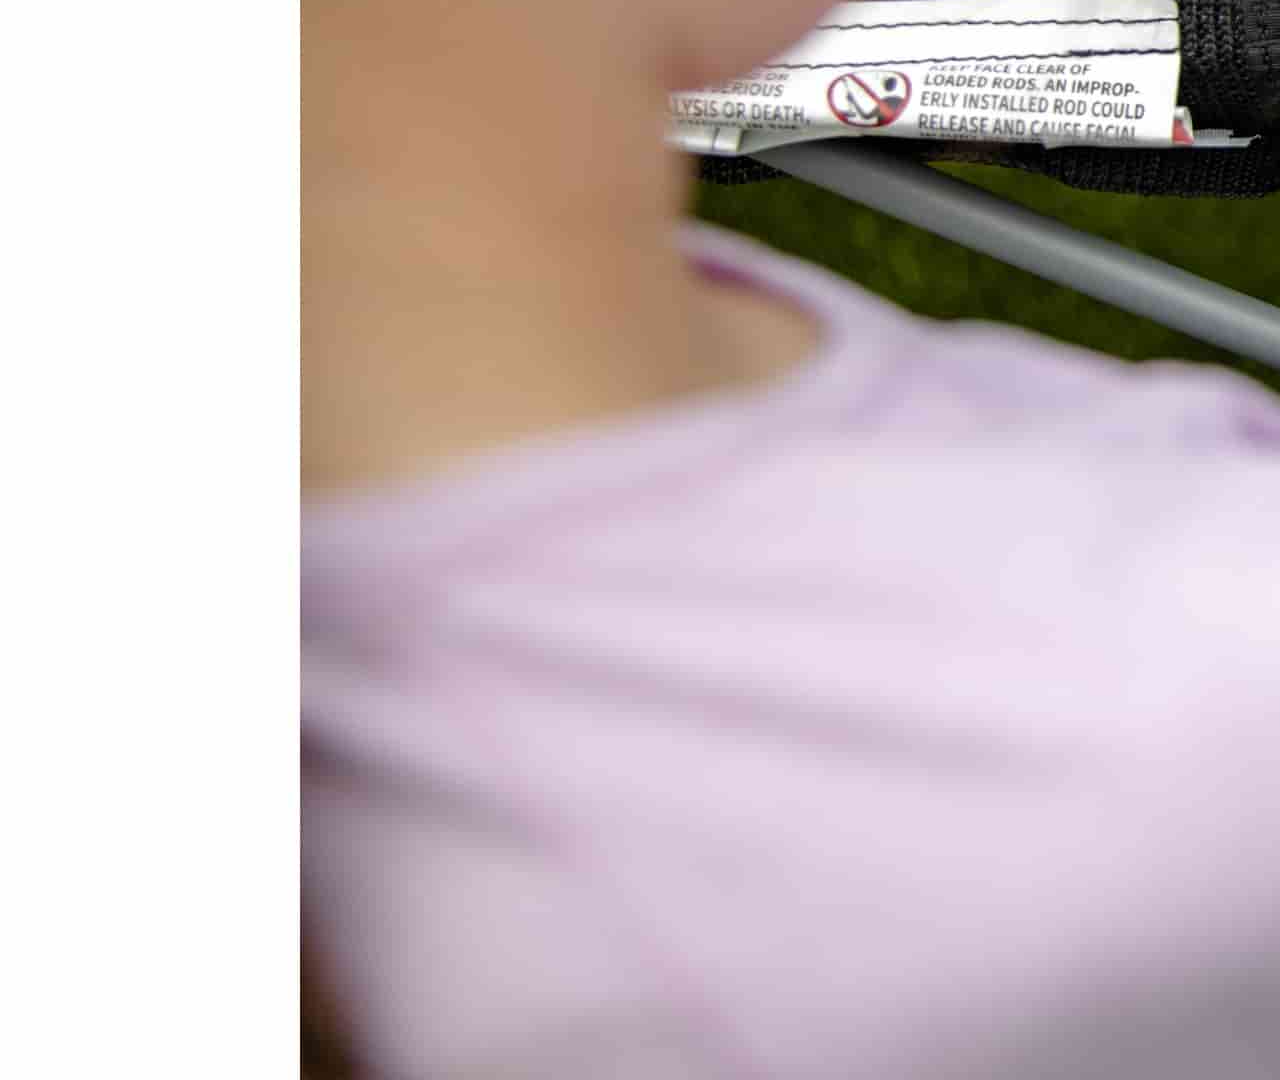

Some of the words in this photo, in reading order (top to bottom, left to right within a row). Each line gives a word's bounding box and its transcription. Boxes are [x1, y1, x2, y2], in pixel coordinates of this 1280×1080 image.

[974, 64, 1012, 73] FACE
[1016, 63, 1066, 75] CLEAR
[1070, 63, 1093, 75] OF
[720, 81, 785, 97] ERIOUS
[924, 74, 988, 89] LOADED
[991, 75, 1040, 91] RODS.
[1044, 80, 1067, 92] AN
[1071, 81, 1141, 96] IMPROP-
[721, 101, 747, 120] OR
[920, 91, 960, 109] ERLY
[963, 93, 1049, 113] INSTALLED
[1052, 99, 1088, 116] ROD
[1091, 101, 1145, 120] COULD
[918, 114, 989, 133] RELEASE
[993, 119, 1026, 136] AND
[1030, 120, 1082, 138] CAUSE
